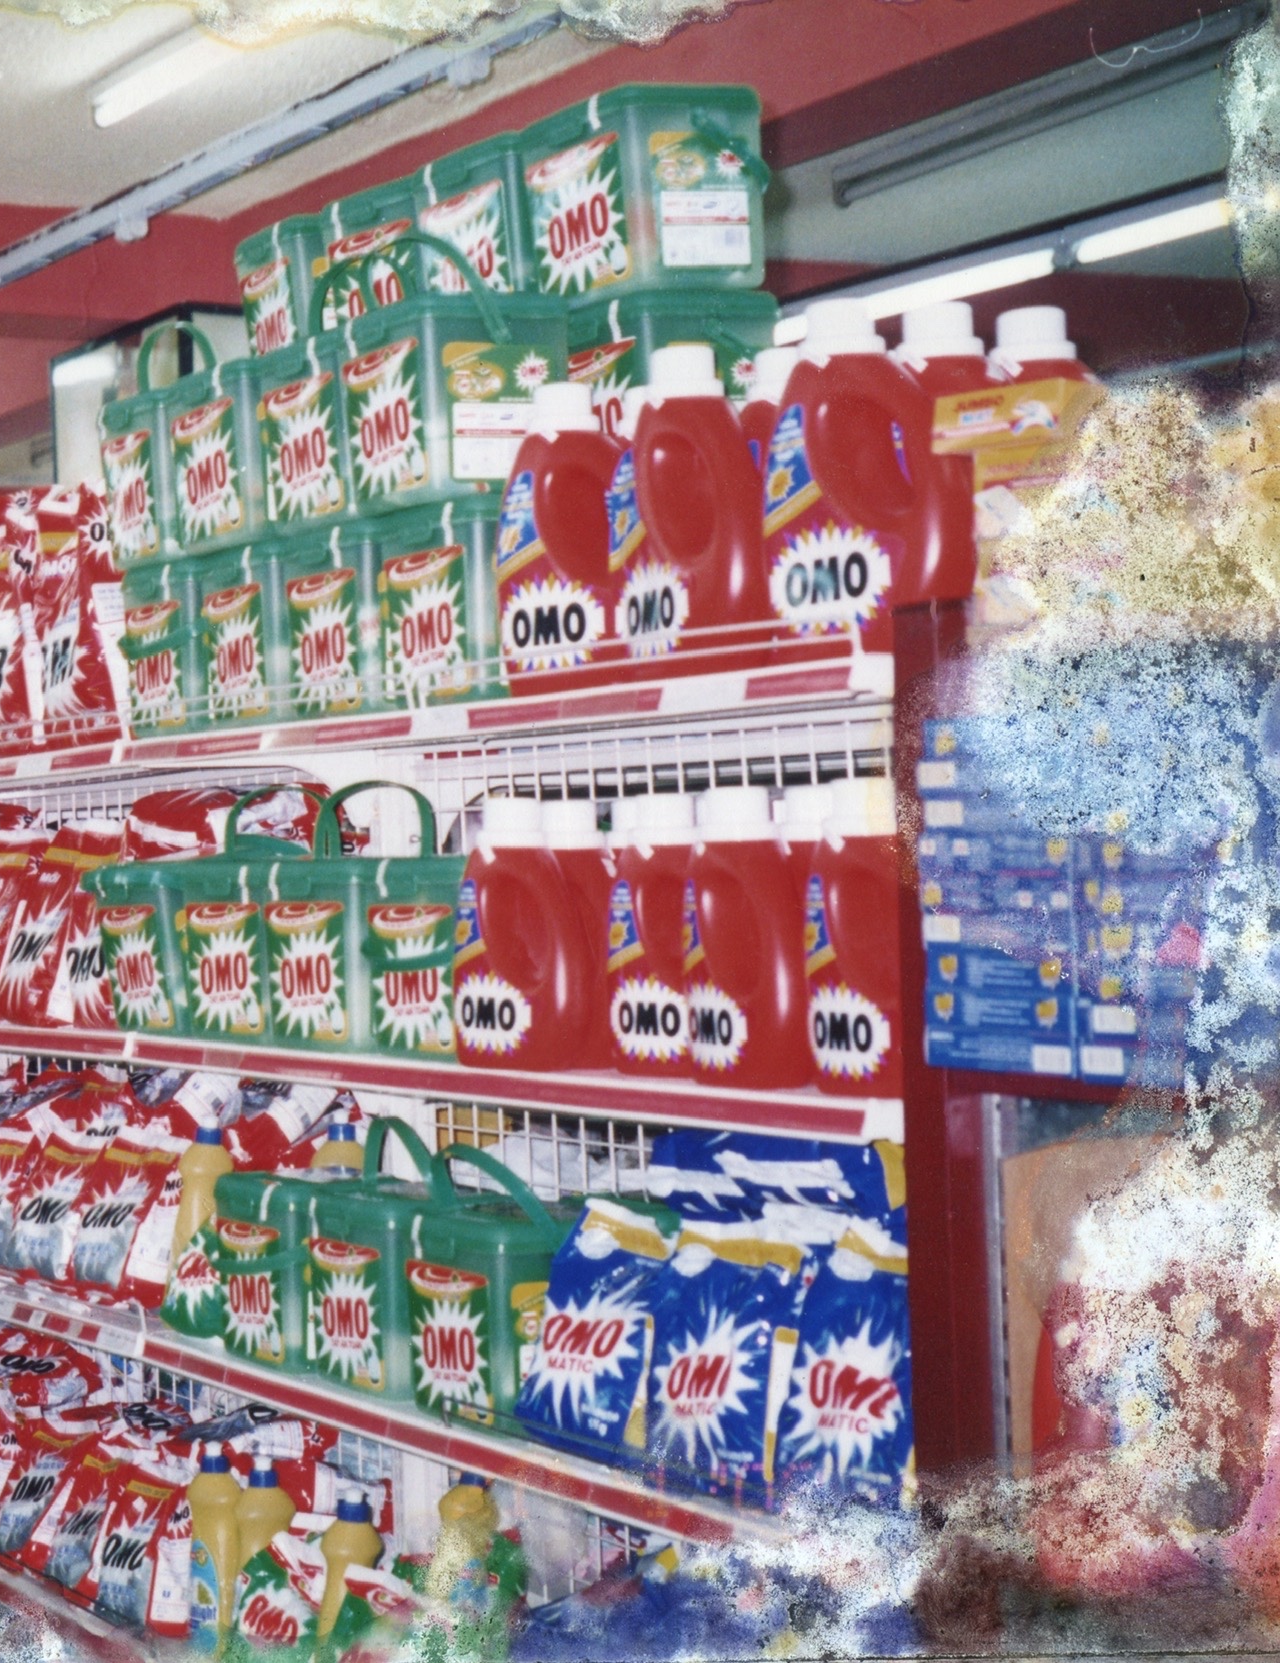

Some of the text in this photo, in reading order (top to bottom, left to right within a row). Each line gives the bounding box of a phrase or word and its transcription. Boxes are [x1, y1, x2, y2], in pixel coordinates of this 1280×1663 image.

[549, 193, 608, 259] OMO
[361, 397, 410, 460] OMO
[186, 449, 227, 505] OMO
[279, 426, 326, 483] OMO
[785, 552, 868, 607] OMO
[400, 602, 454, 660] OMO
[512, 602, 587, 648] OMO
[628, 586, 675, 635] OMO
[216, 632, 255, 684] OMO
[301, 622, 347, 674] OMO
[136, 649, 173, 695] OMO
[115, 950, 154, 994] OMO
[200, 950, 249, 995] OMO
[280, 952, 332, 999] OMO
[384, 967, 439, 1008] OMO
[462, 995, 516, 1031] OMO
[620, 1002, 681, 1037] OMO
[690, 1006, 733, 1046] OMO
[814, 1011, 873, 1052] OMO
[20, 1197, 68, 1224] OMO
[82, 1202, 136, 1228] OMO
[228, 1273, 271, 1315] OMO
[322, 1295, 369, 1340] OMO
[543, 1314, 625, 1358] OMO
[423, 1325, 475, 1373] OMO
[547, 1356, 594, 1374] MATIC
[818, 1413, 870, 1434] MATIC
[11, 1476, 55, 1502] OMO
